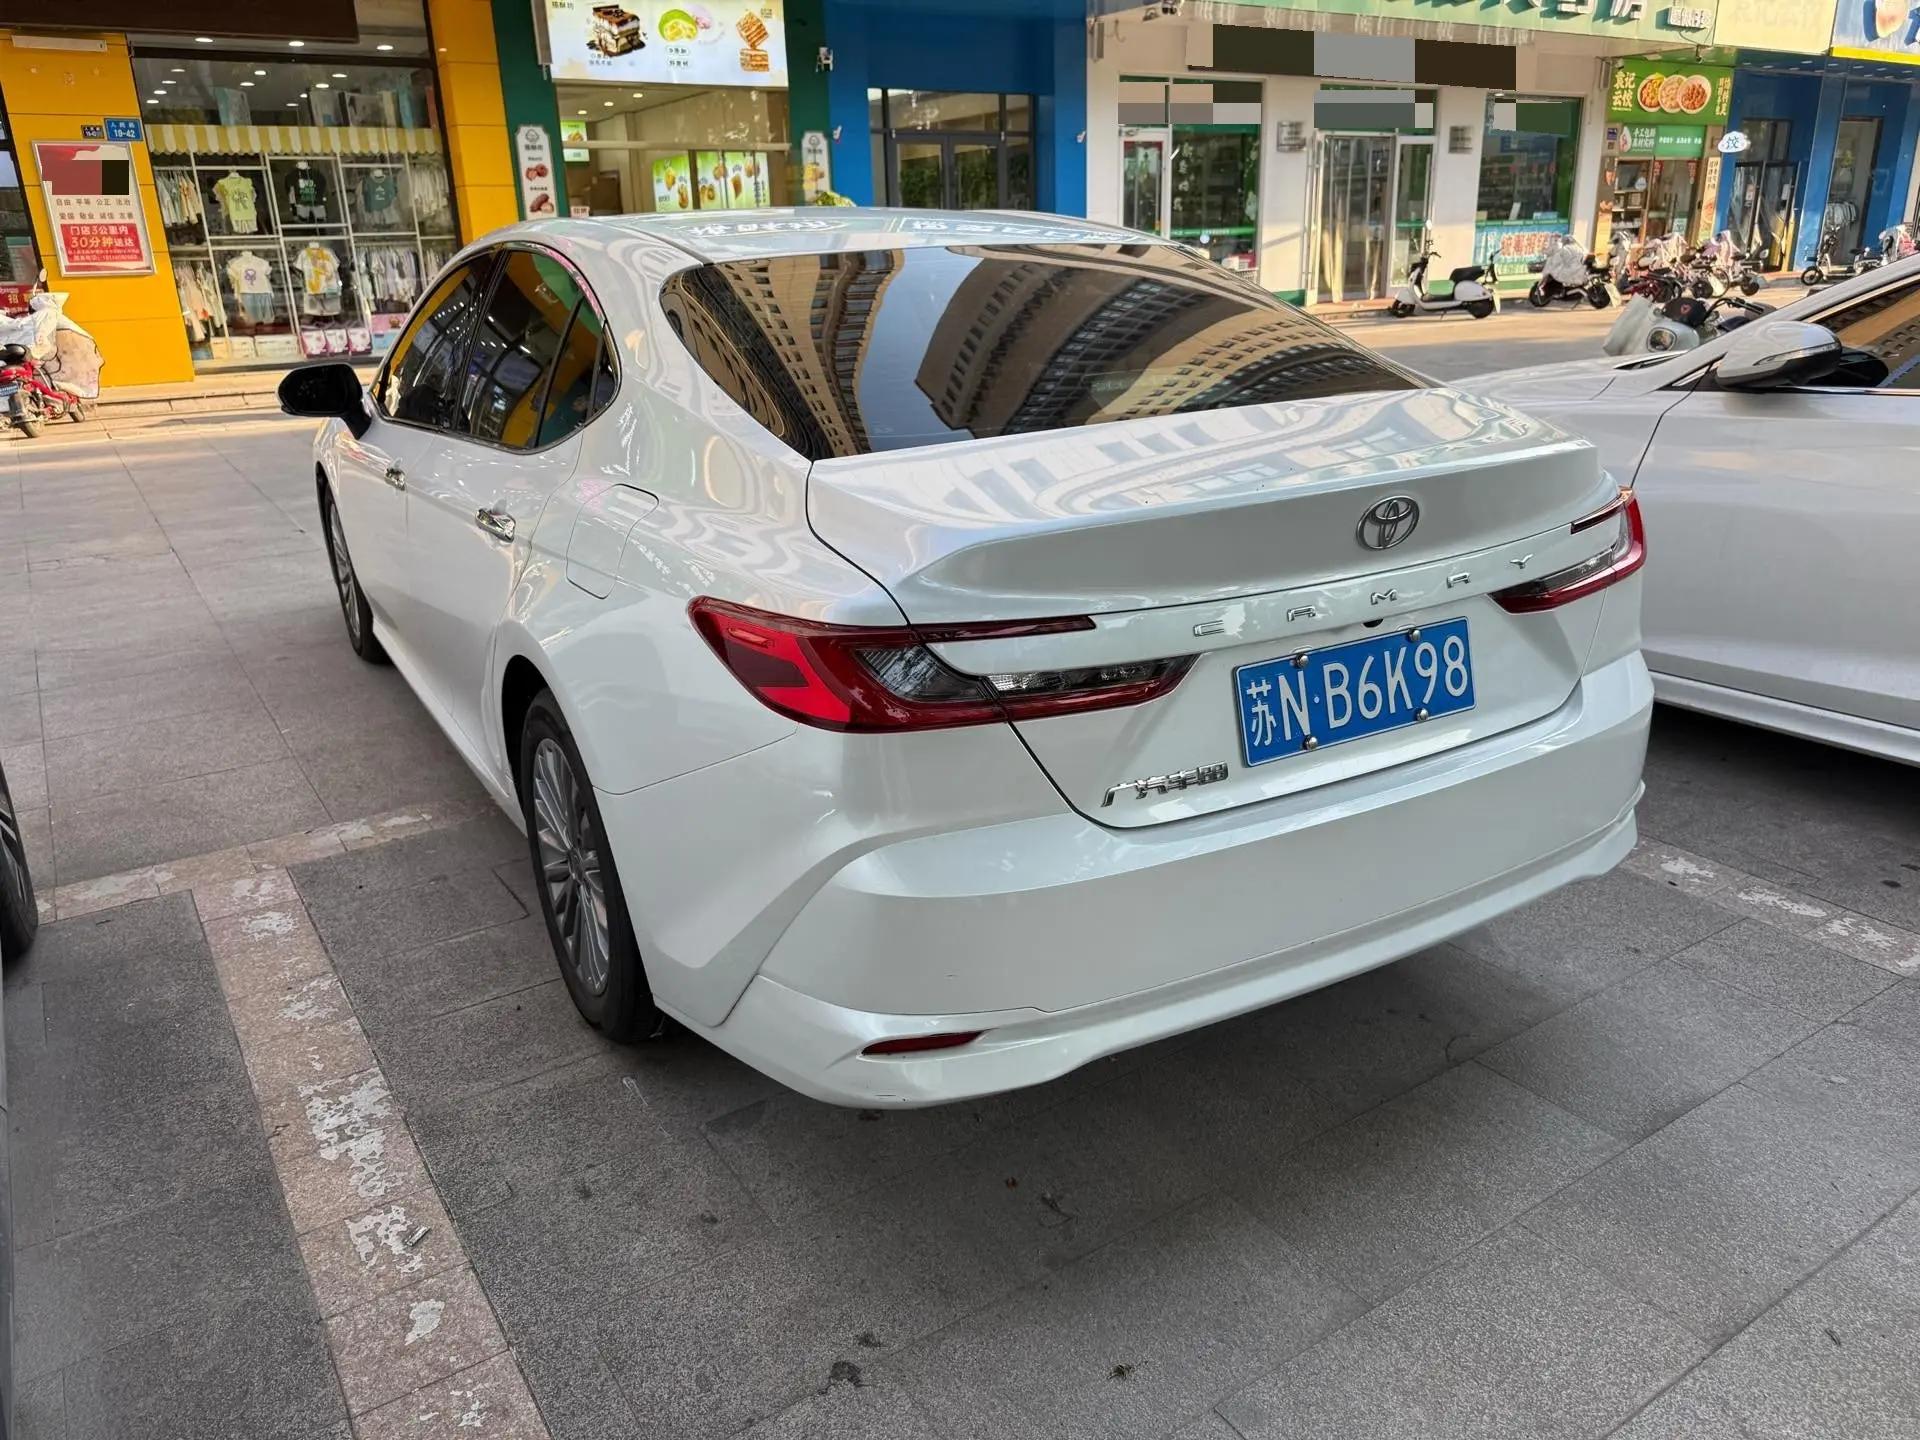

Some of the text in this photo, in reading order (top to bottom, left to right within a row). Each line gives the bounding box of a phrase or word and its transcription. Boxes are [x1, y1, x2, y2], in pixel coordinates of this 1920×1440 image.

[70, 225, 129, 236] 门店3公里内
[70, 236, 135, 249] 30分钟送达
[1193, 553, 1534, 638] CAMRY
[1246, 635, 1469, 748] 苏N·B6K98
